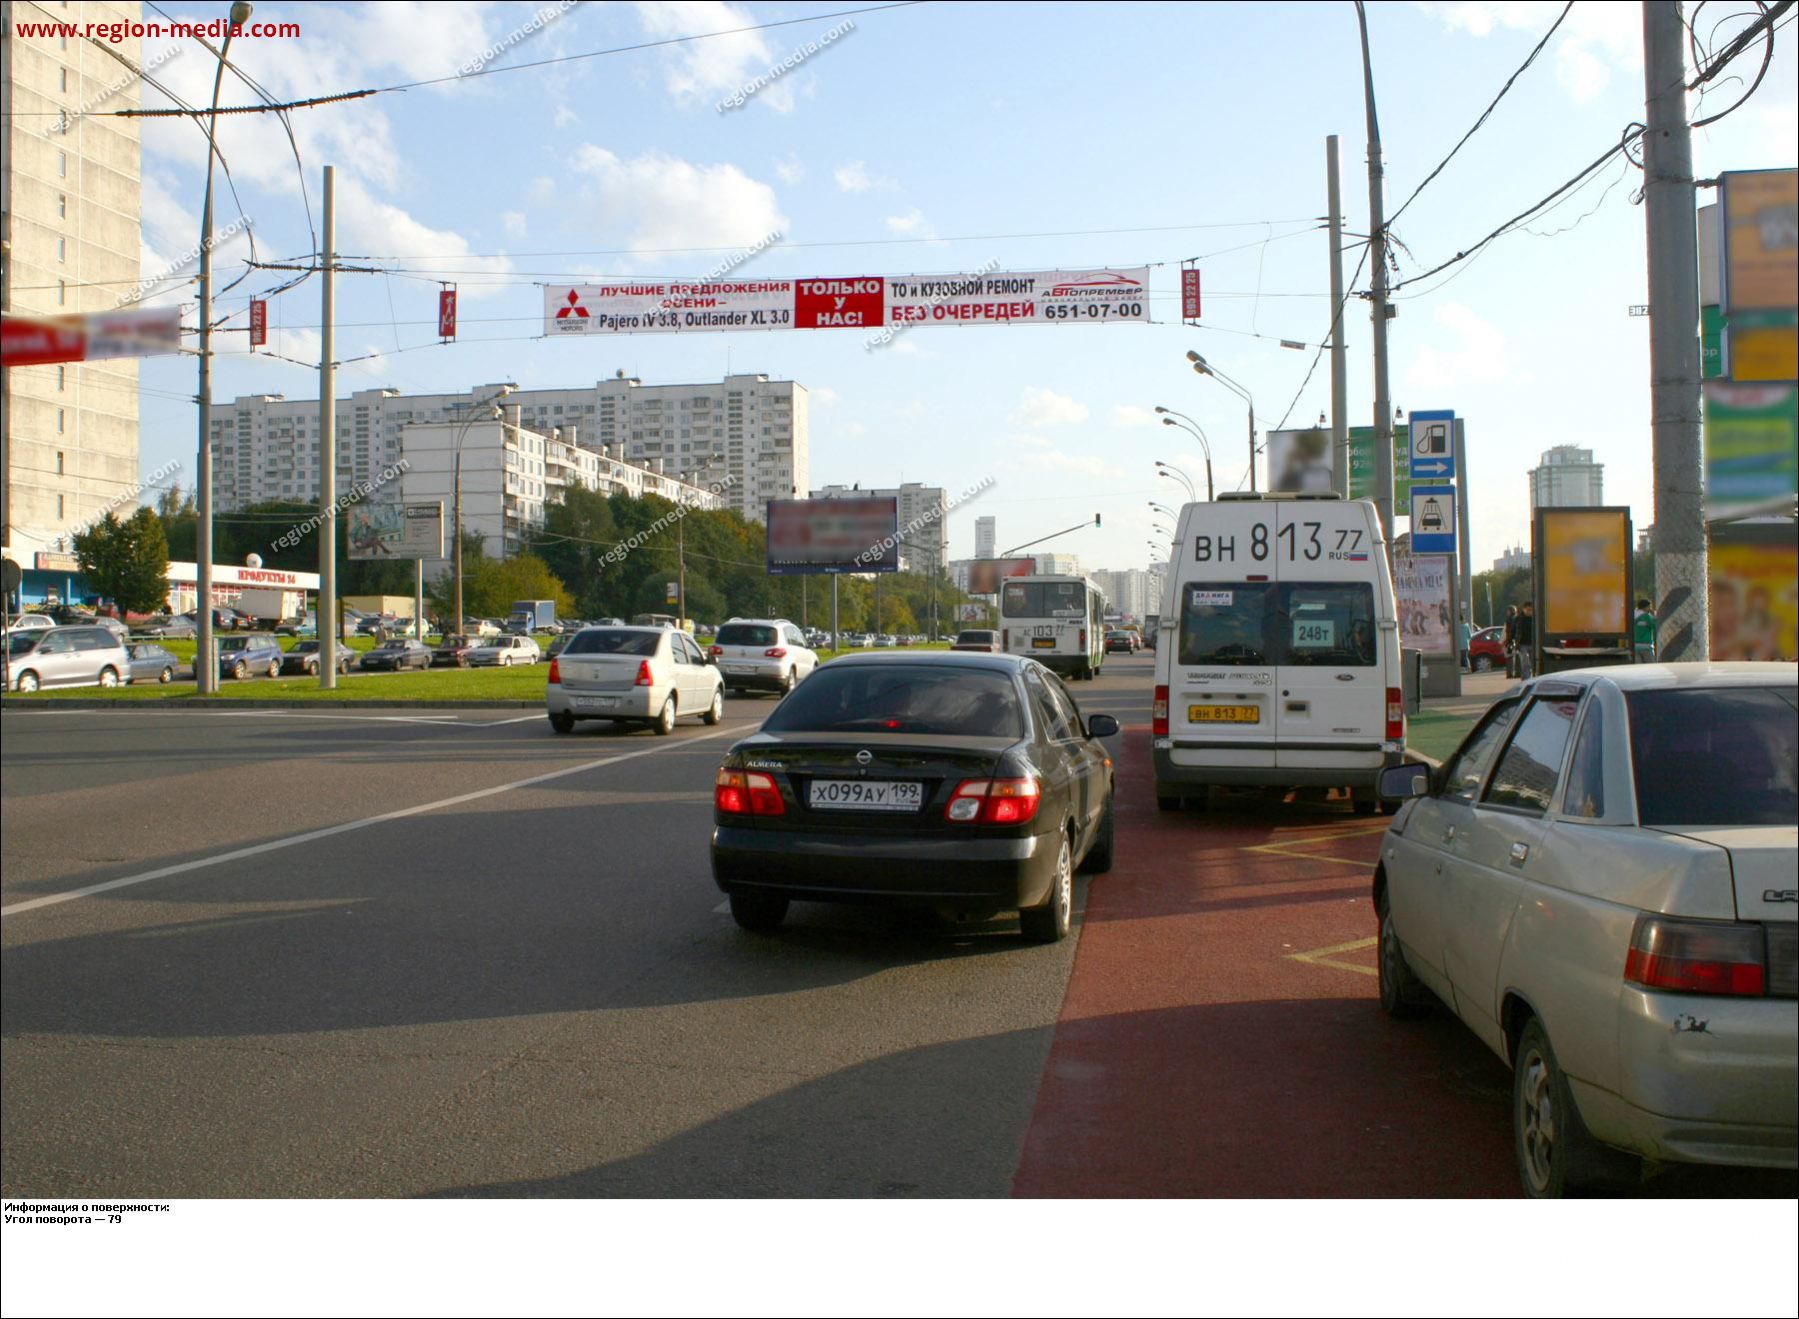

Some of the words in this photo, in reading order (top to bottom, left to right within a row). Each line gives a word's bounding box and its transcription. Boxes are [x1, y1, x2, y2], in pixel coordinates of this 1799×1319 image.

[600, 285, 665, 297] ЛУЧШИЕ
[670, 282, 790, 295] ПРЕДЛОЖЕНИЯ
[800, 280, 880, 296] ТОЛЬКО
[891, 283, 907, 298] ТО
[911, 287, 918, 298] и
[921, 277, 984, 298] КУЗОВНОЙ
[987, 278, 1036, 295] РЕМОНТ
[834, 297, 846, 310] У
[892, 305, 927, 321] БЕЗ
[933, 299, 1035, 321] ОЧЕРЕДЕЙ
[1045, 302, 1142, 319] 651-07-00
[600, 313, 639, 331] Pajero
[686, 310, 748, 326] Outlander
[750, 310, 767, 325] XL
[771, 309, 790, 324] 3.0
[816, 311, 863, 326] НАС!
[1195, 535, 1235, 562] ВН
[1251, 522, 1322, 562] 813
[1335, 530, 1363, 550] 77
[1328, 551, 1350, 561] RUS
[1033, 625, 1053, 637] 103
[1214, 707, 1236, 719] 813
[816, 783, 886, 802] Х099АУ
[891, 783, 918, 798] 199
